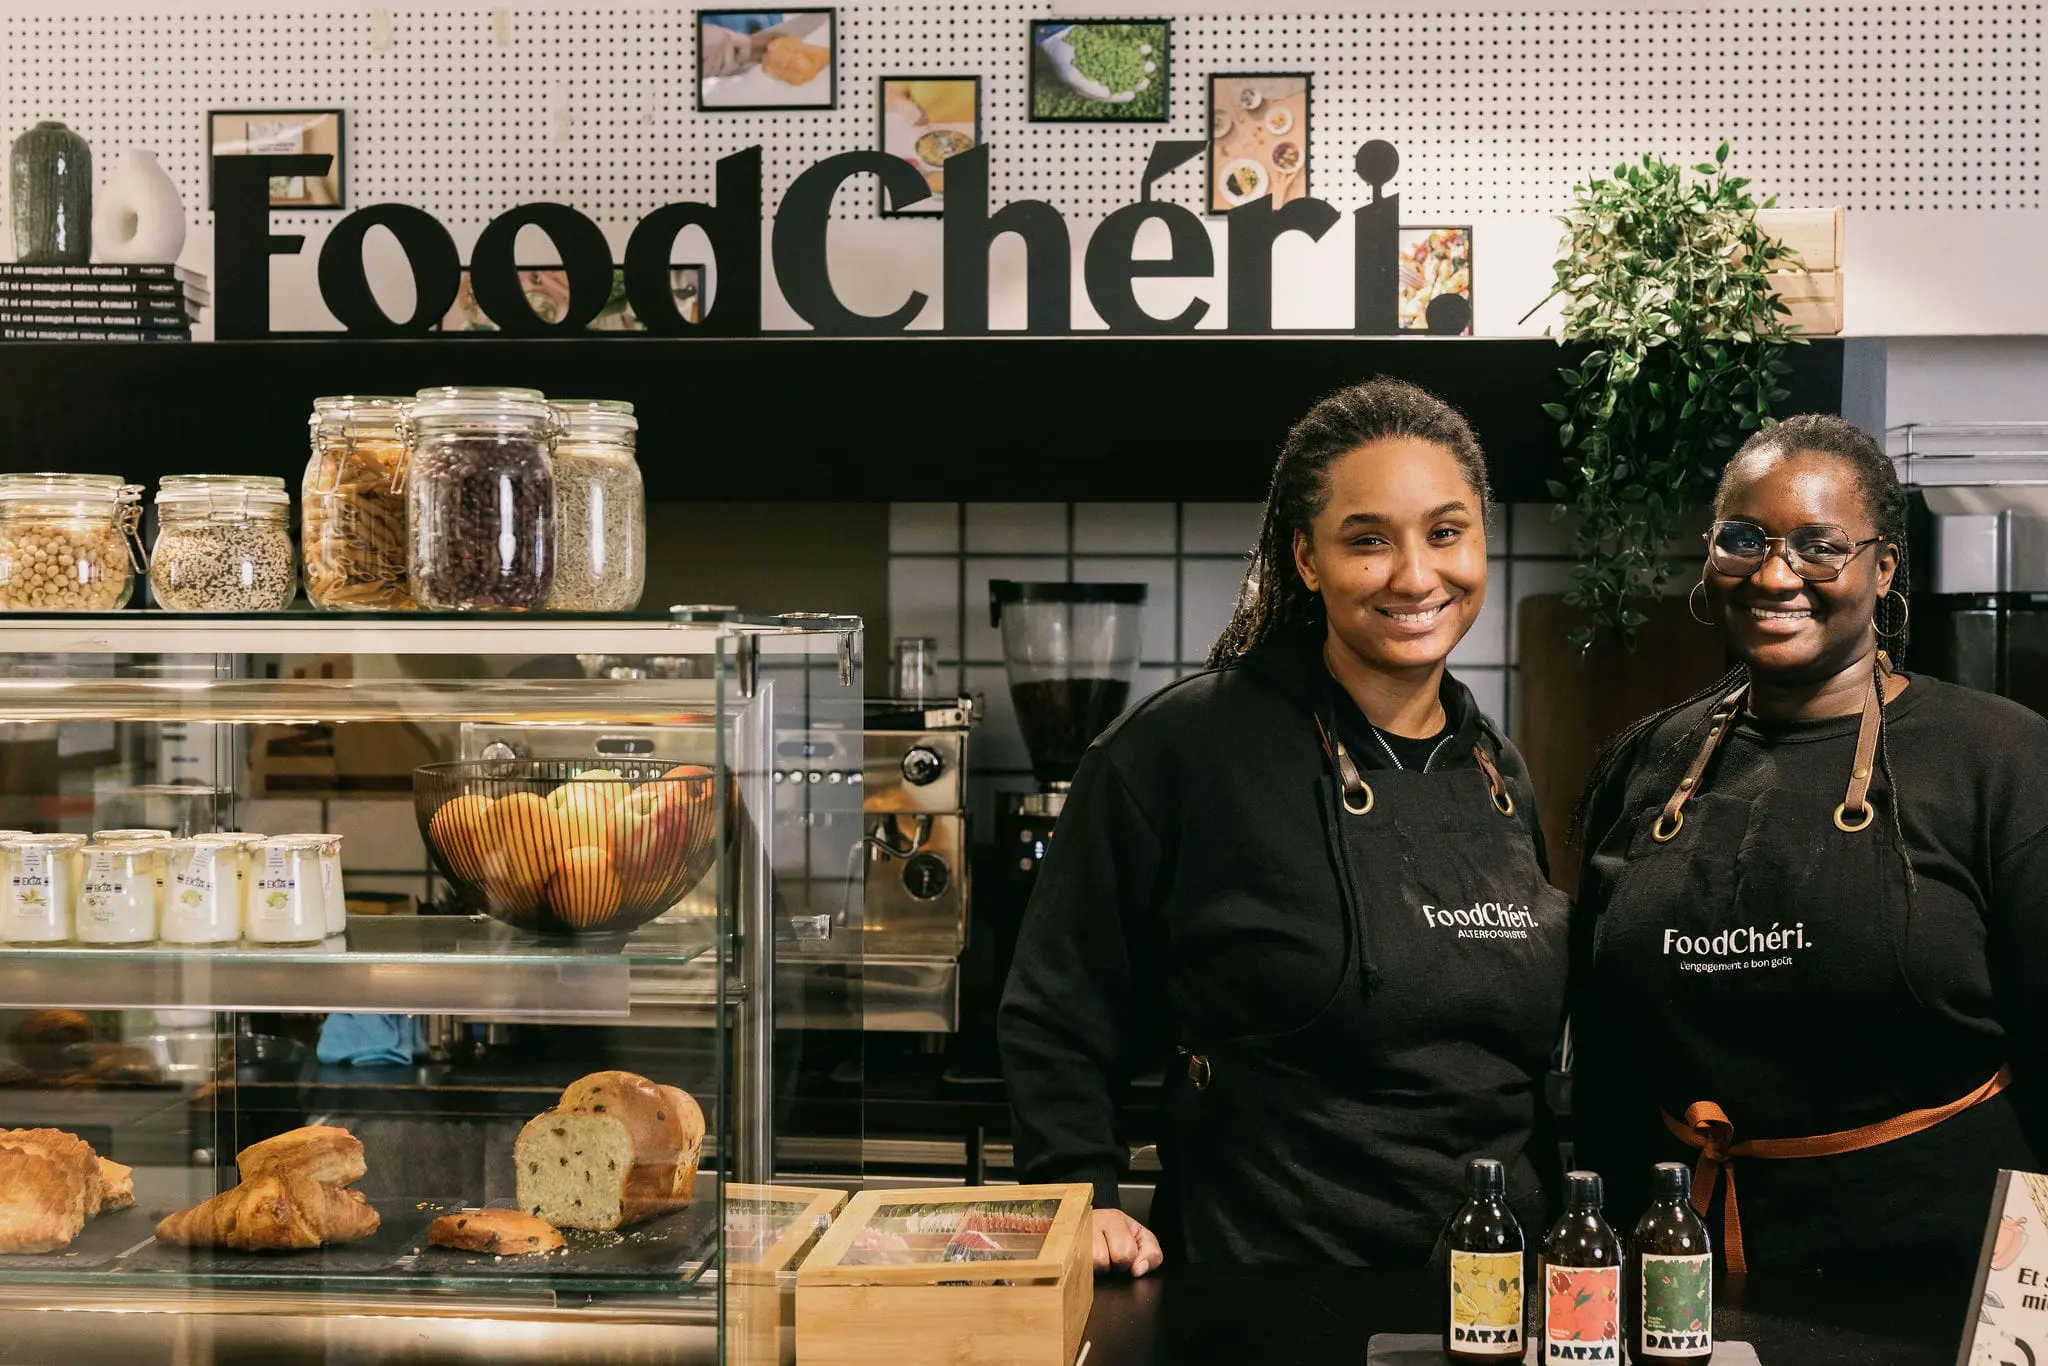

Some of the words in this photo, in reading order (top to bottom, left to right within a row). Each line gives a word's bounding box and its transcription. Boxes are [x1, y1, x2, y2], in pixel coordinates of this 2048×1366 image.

[214, 139, 1472, 338] FoodChéri.
[1422, 902, 1538, 928] FoodChéri.
[1458, 930, 1528, 939] ALTERFOODISTS
[1664, 922, 1812, 956] FoodChéri.
[1751, 959, 1770, 968] bon
[2018, 1267, 2039, 1286] Et
[2022, 1294, 2048, 1311] mi
[1455, 1328, 1518, 1343] DATXA
[1646, 1334, 1708, 1350] DATXA
[1550, 1344, 1615, 1360] DATXA
